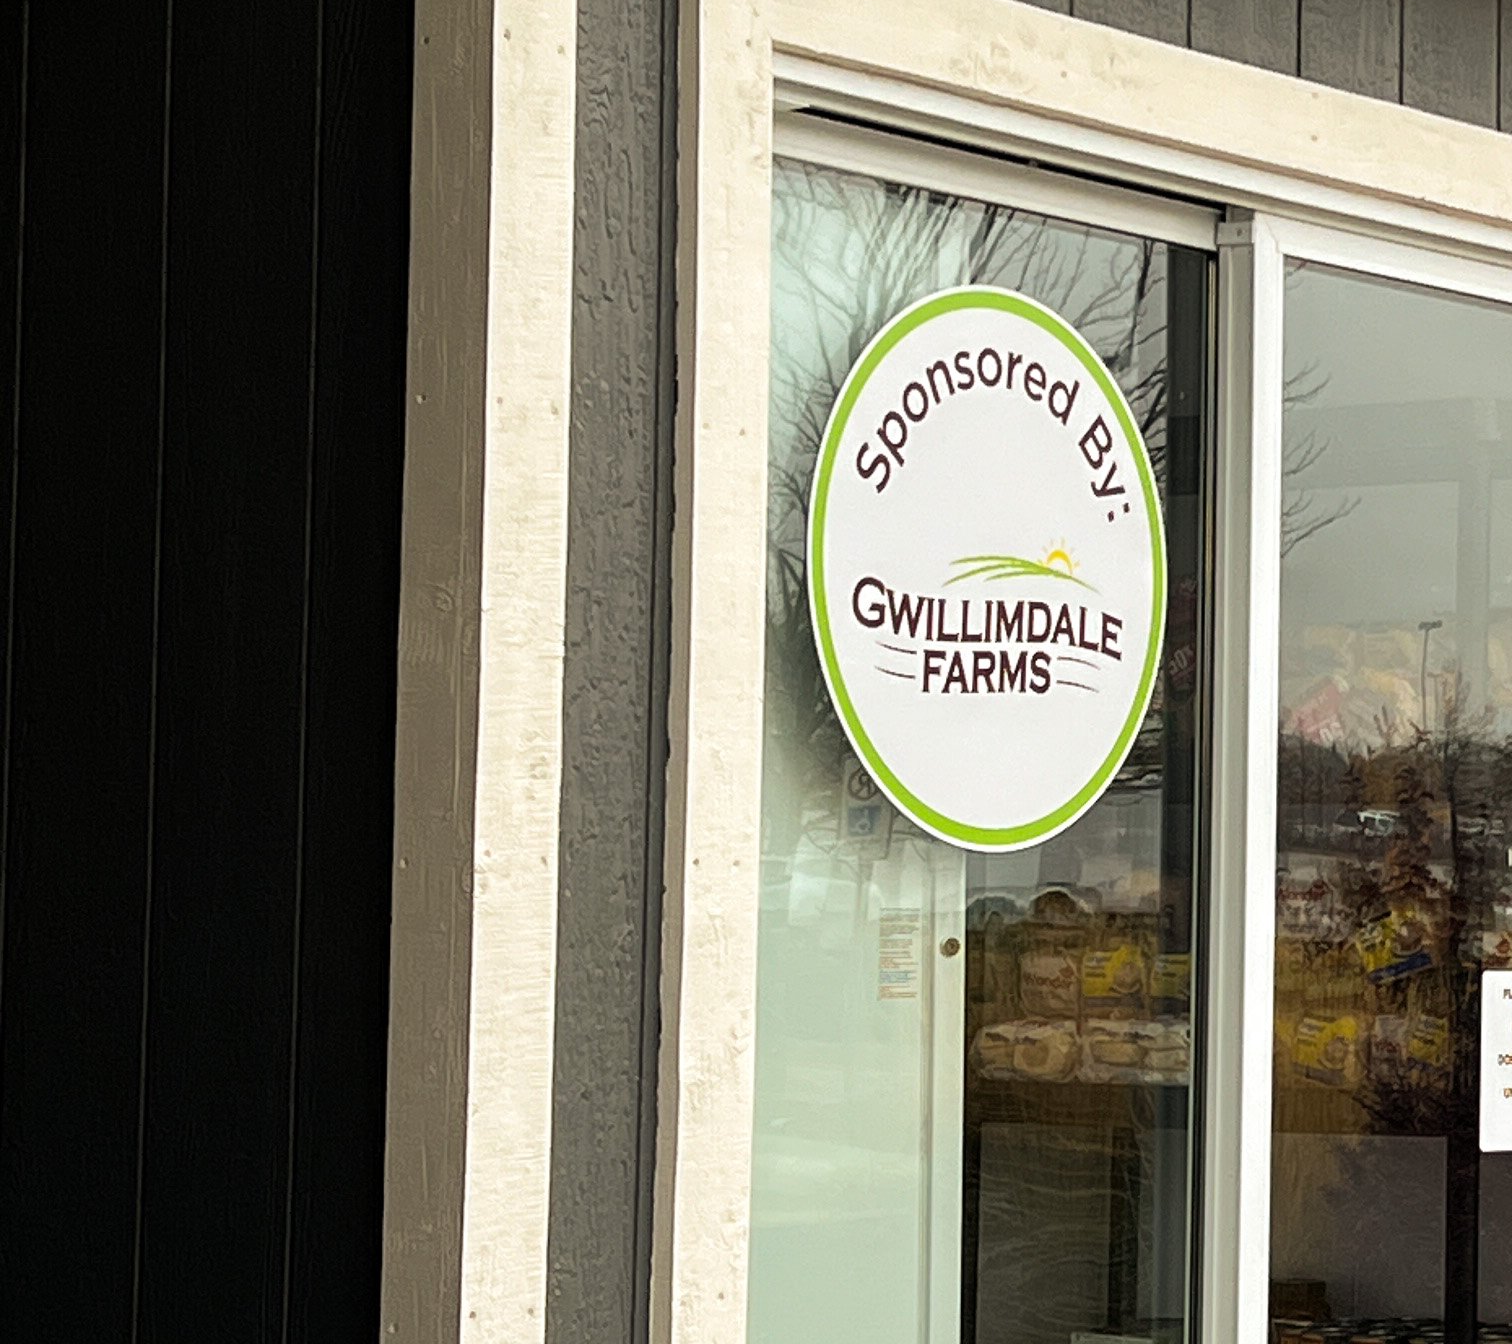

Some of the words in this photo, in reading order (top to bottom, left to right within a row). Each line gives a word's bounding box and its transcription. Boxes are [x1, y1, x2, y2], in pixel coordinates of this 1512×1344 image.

[856, 346, 1080, 494] Sponsored
[1077, 414, 1131, 522] By:
[852, 575, 1124, 661] GWILLIMDALE
[921, 649, 1052, 695] FARMS
